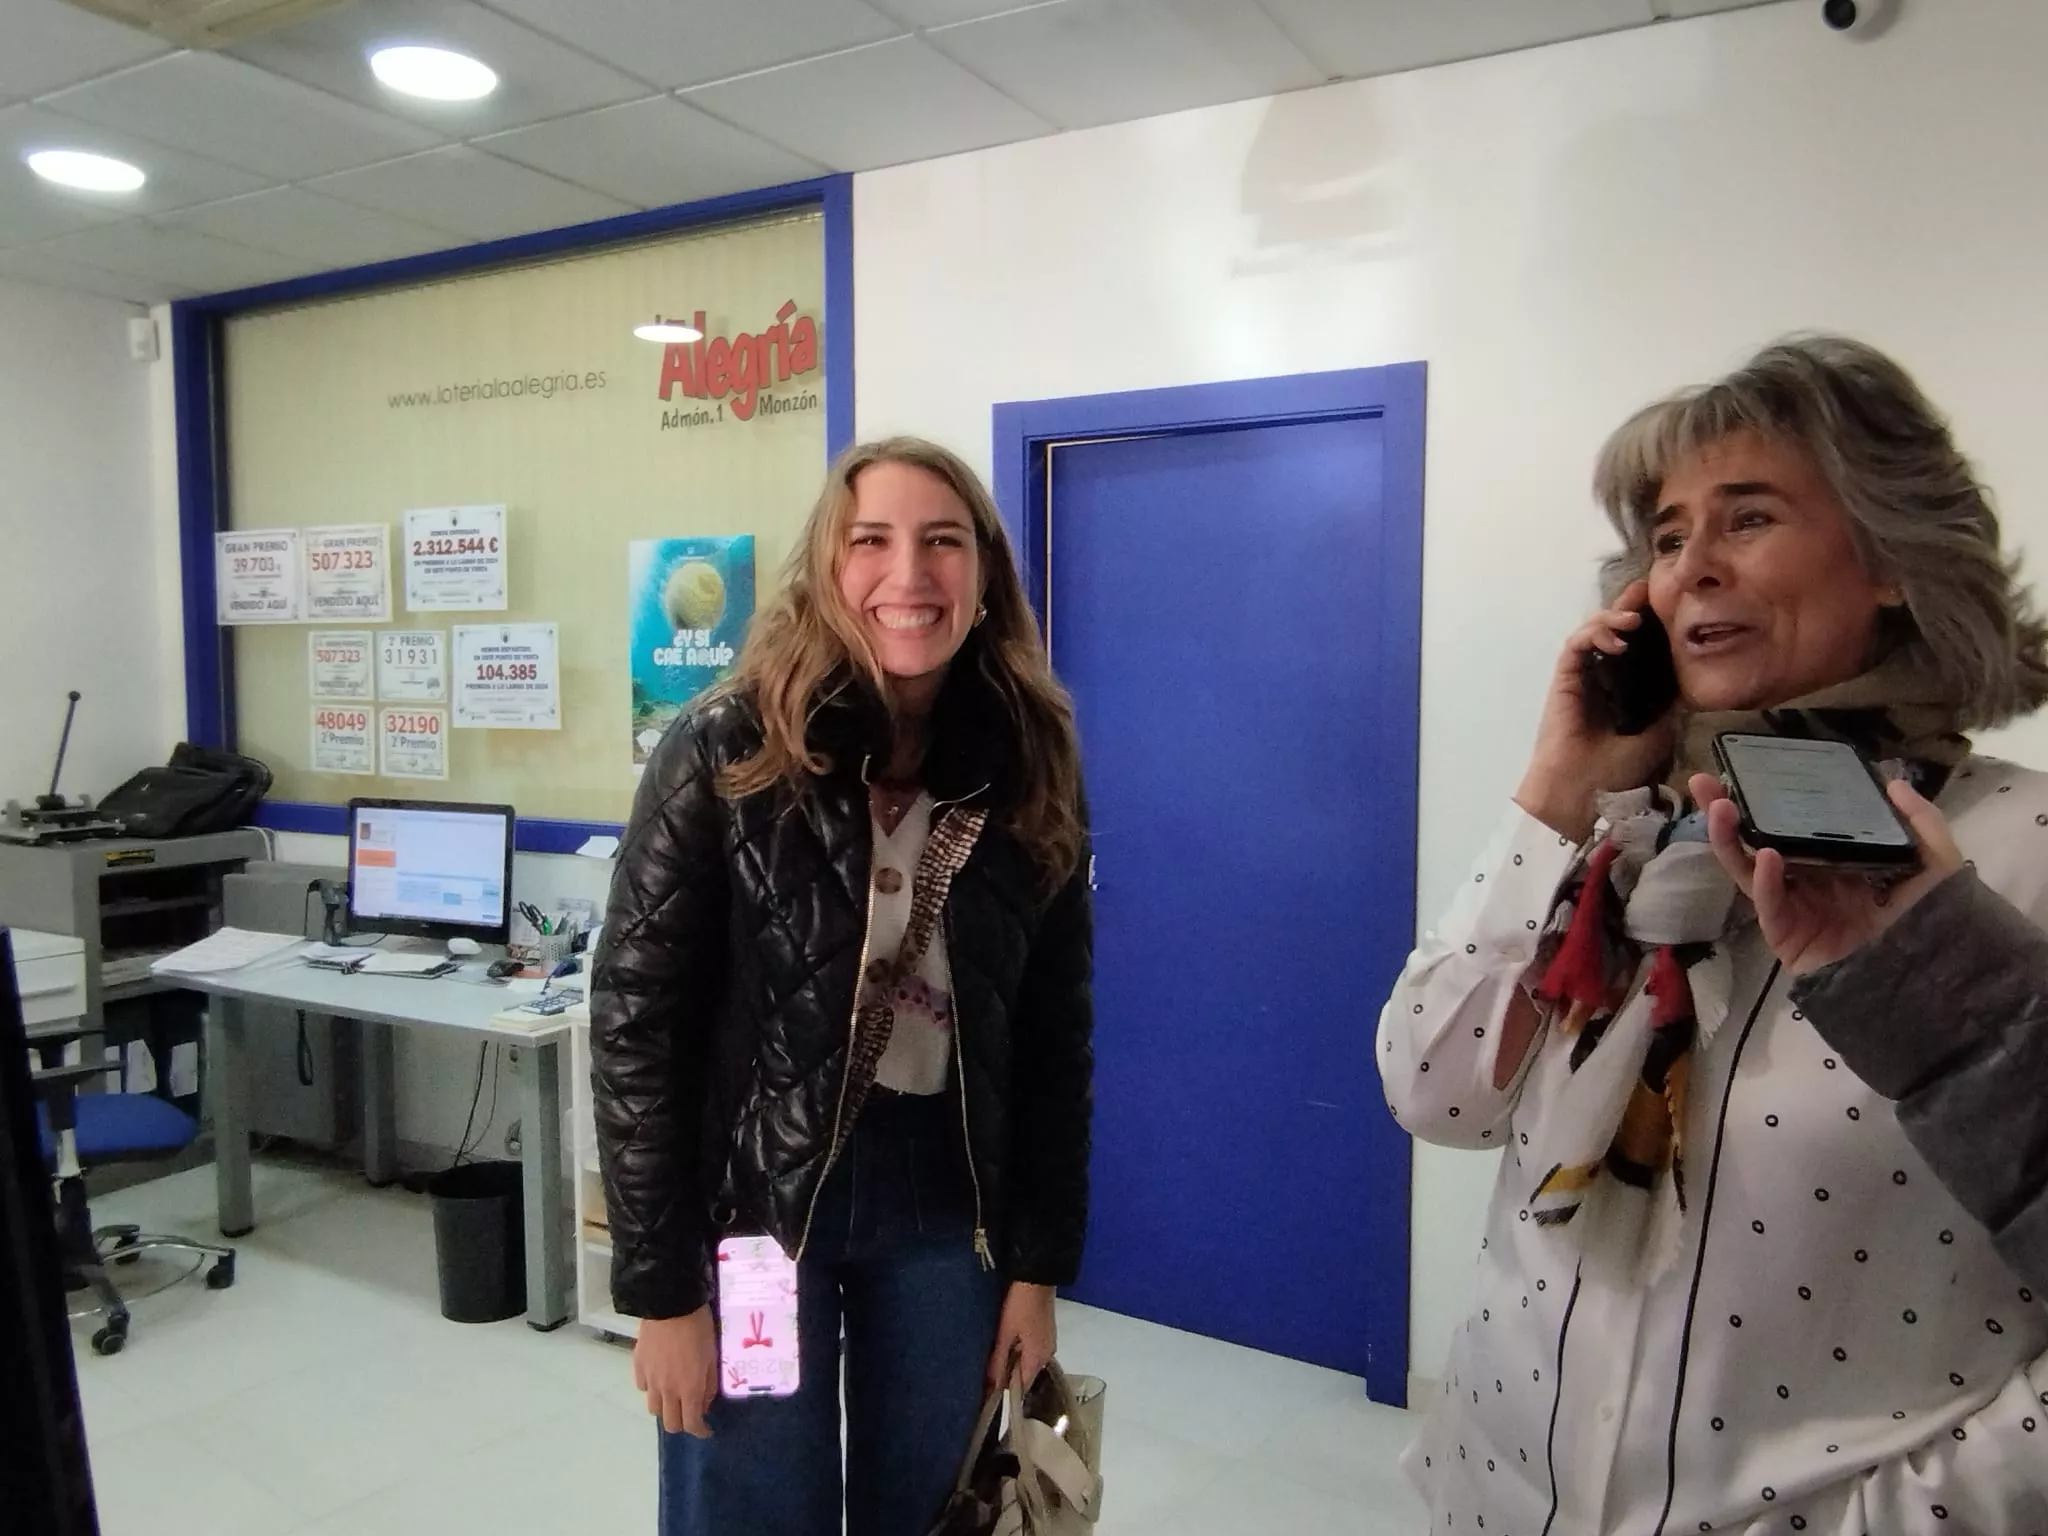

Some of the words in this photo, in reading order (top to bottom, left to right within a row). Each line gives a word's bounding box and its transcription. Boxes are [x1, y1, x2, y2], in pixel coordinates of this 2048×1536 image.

[658, 299, 818, 421] Alegría
[387, 369, 609, 408] www.loterialaalegria.es
[760, 389, 817, 416] Monzón
[225, 543, 250, 554] GRAN
[253, 540, 288, 553] PREMIO
[412, 537, 485, 556] 2.312.544
[488, 536, 499, 554] €
[400, 635, 435, 647] PREMIO
[694, 629, 710, 648] SI
[653, 647, 683, 666] CAE
[476, 663, 537, 681] 104.385
[316, 711, 367, 732] 48049
[386, 714, 440, 735] 32190
[330, 732, 364, 746] Premio
[400, 736, 437, 750] Premio
